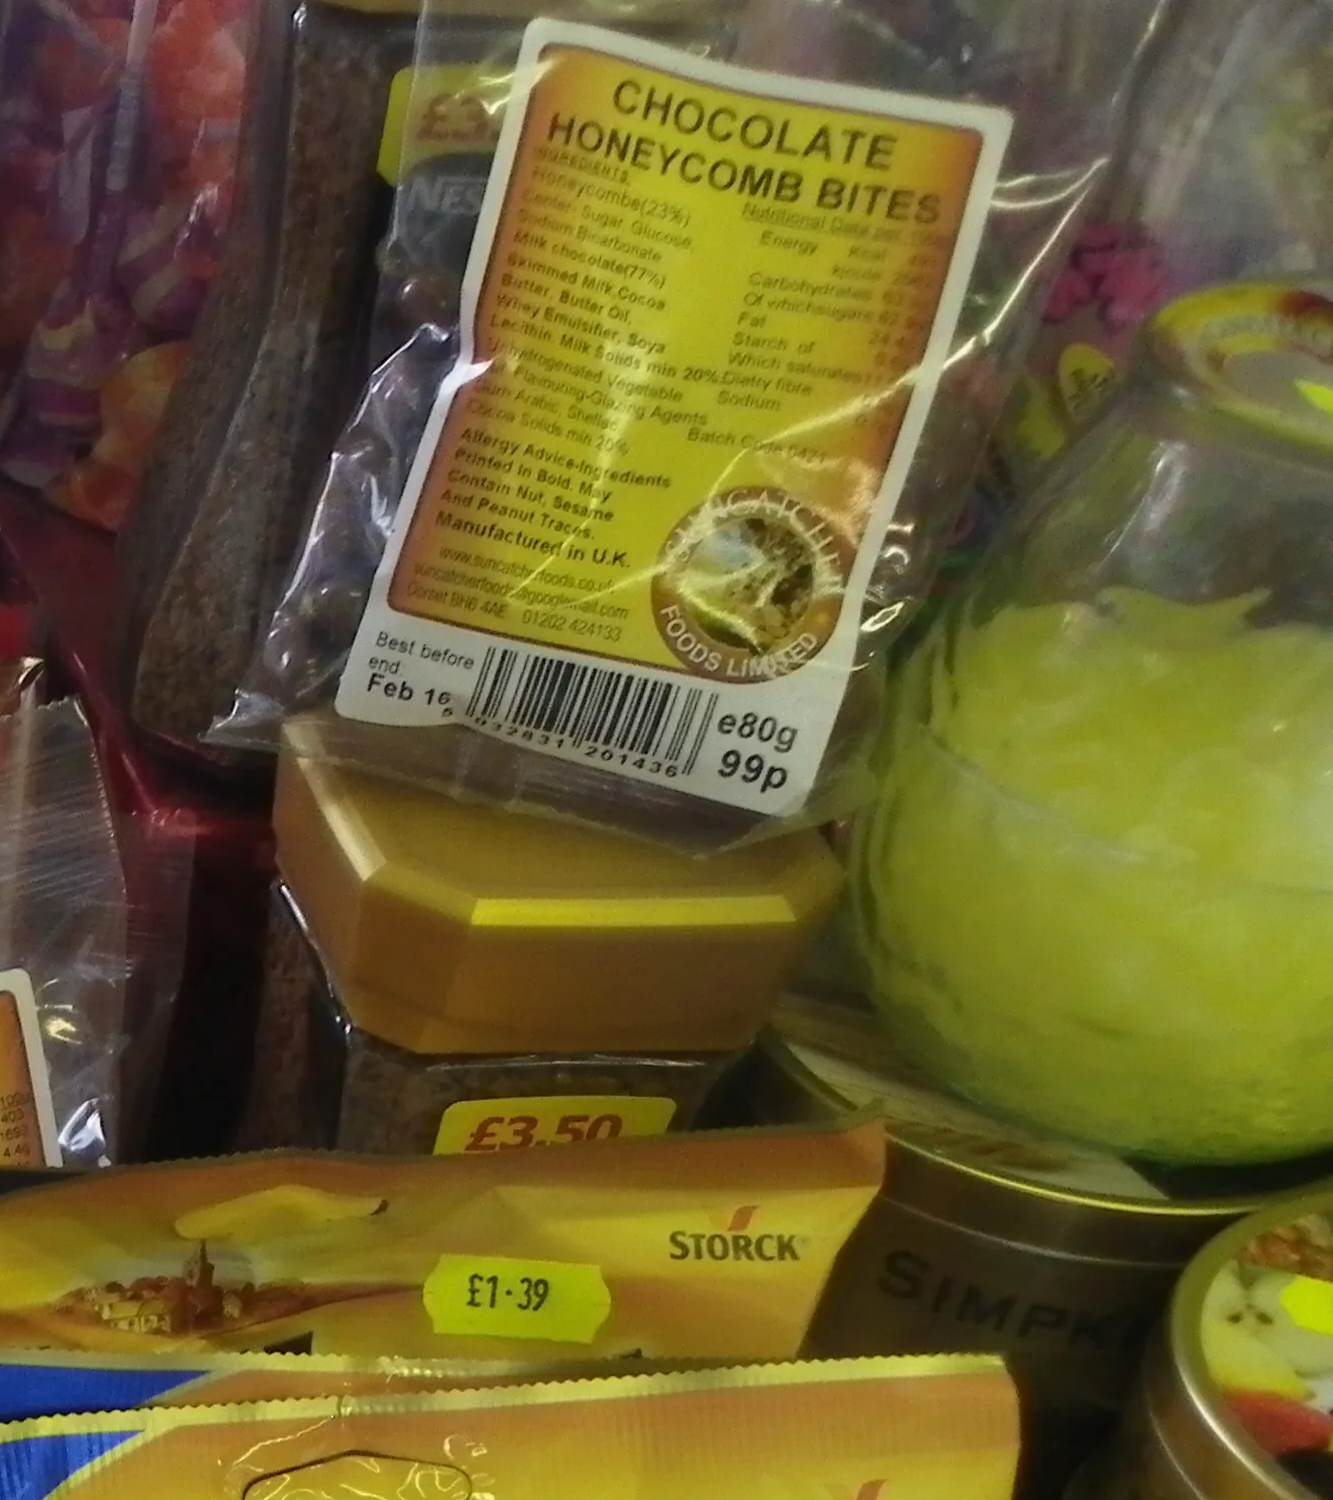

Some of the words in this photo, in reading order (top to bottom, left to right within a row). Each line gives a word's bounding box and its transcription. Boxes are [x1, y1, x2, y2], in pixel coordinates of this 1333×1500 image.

[613, 78, 899, 172] CHOCOLATE
[546, 112, 802, 206] HONEYCOMB
[815, 176, 941, 227] BITES
[435, 510, 563, 557] Manufactured
[567, 543, 586, 562] in
[593, 548, 631, 568] U.K.
[374, 631, 417, 656] Best
[420, 641, 476, 671] before
[366, 673, 413, 703] Feb
[717, 712, 798, 754] e80g
[717, 749, 789, 792] 99p
[464, 1114, 623, 1153] £3.50
[669, 1231, 801, 1262] STORCK
